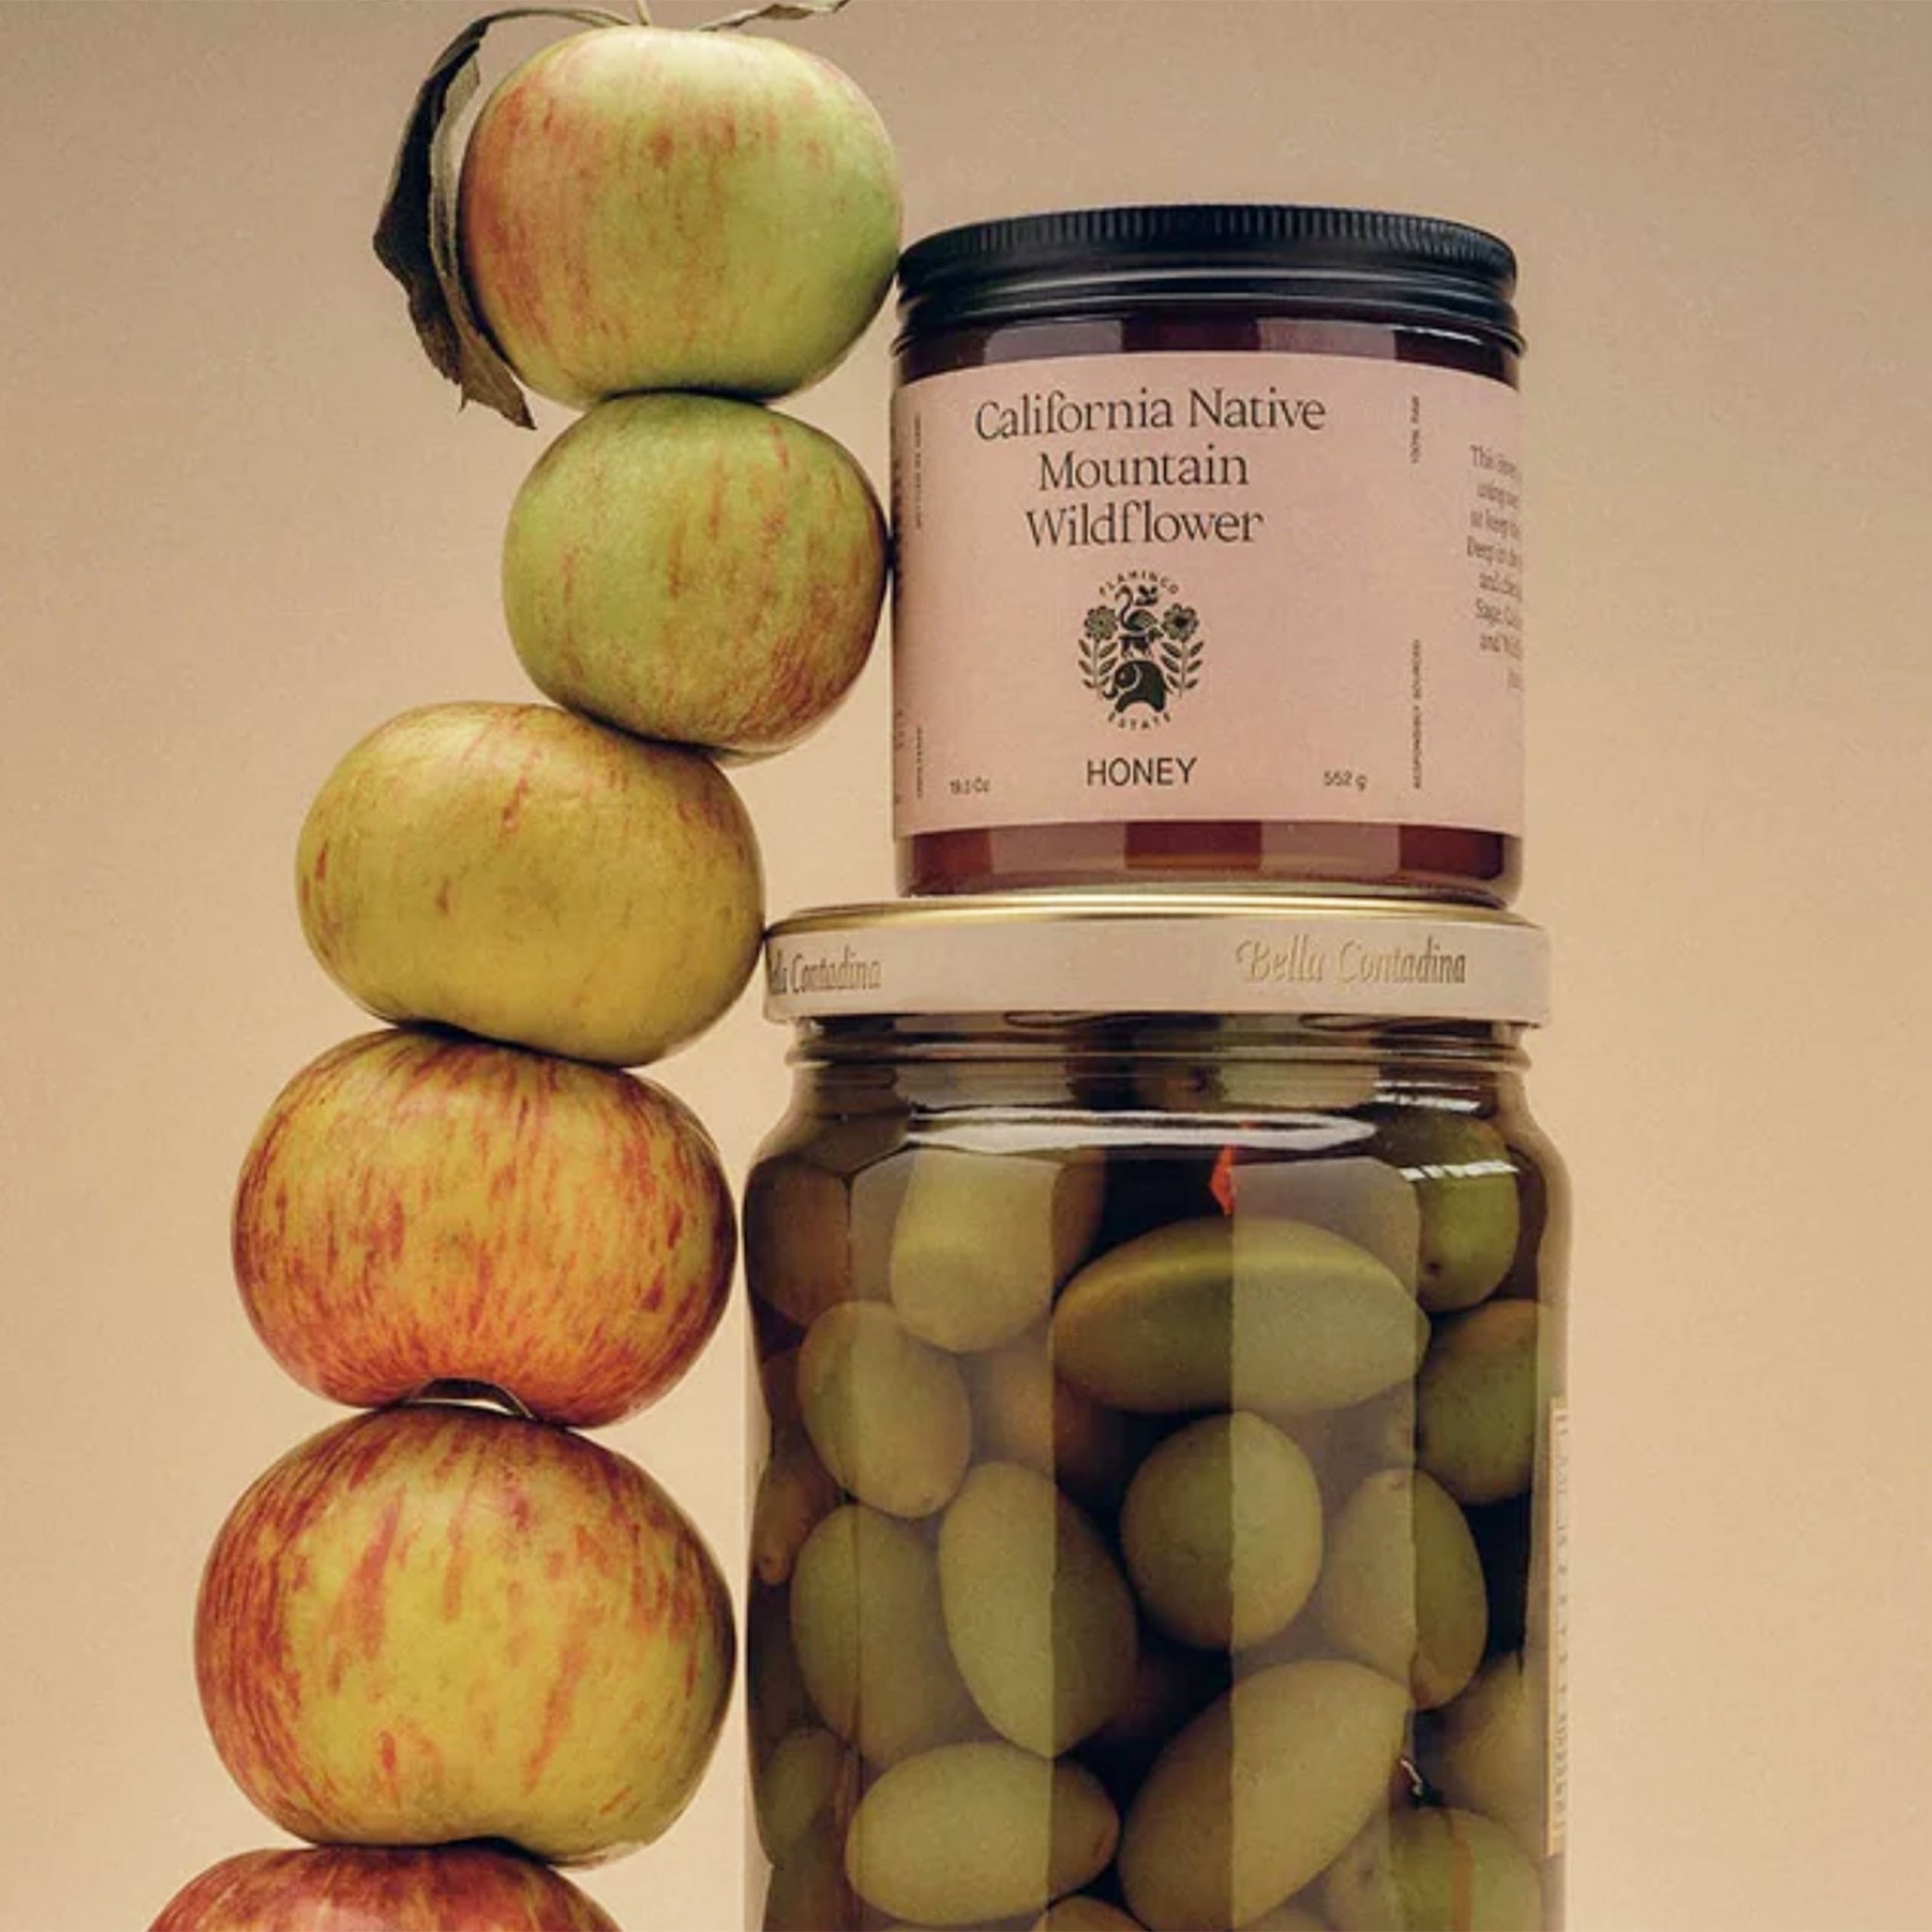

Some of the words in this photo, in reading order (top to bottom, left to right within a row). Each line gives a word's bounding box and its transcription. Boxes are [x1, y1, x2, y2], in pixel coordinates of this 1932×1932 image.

[974, 387, 1174, 441] California
[1189, 386, 1327, 430] Native
[1038, 443, 1250, 491] Mountain
[1024, 499, 1265, 548] Wildflower
[1086, 758, 1198, 787] HONEY
[1355, 774, 1367, 793] g
[791, 943, 883, 993] Contadina
[1235, 933, 1324, 984] Bella
[1339, 934, 1467, 985] Contadina
